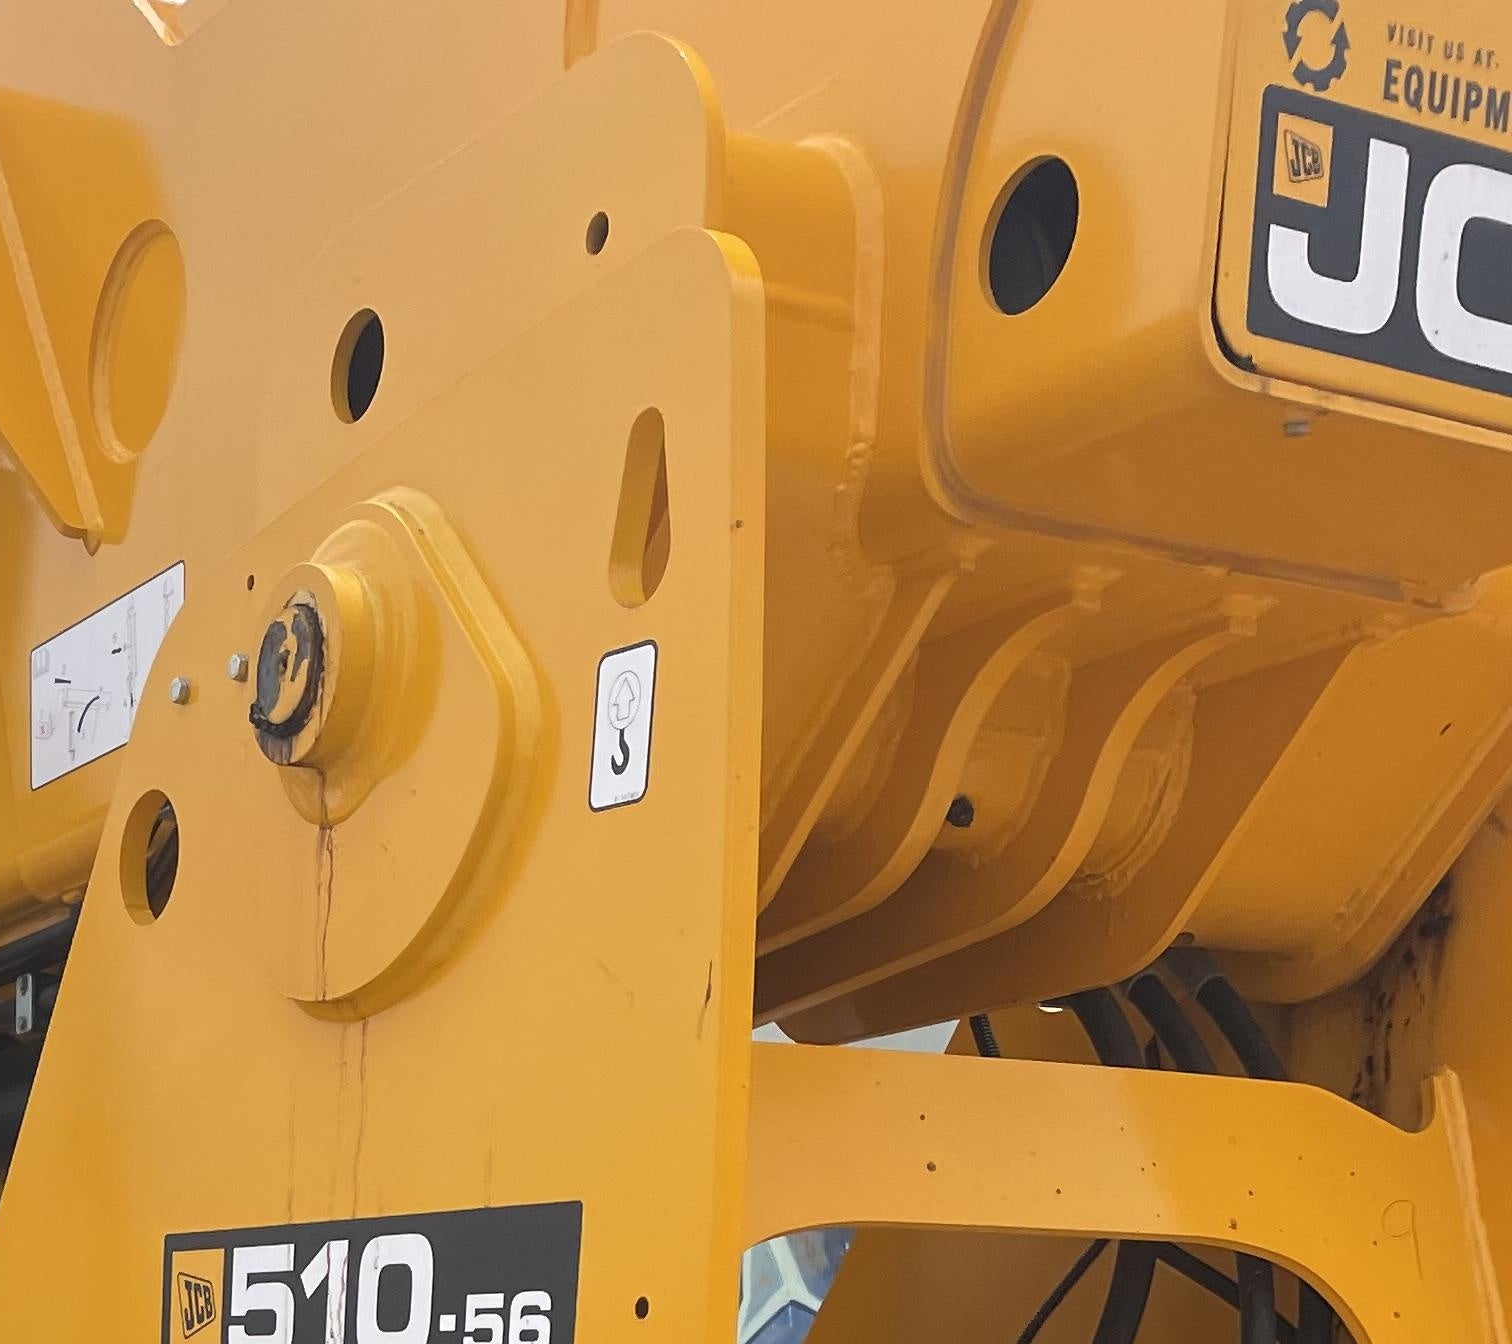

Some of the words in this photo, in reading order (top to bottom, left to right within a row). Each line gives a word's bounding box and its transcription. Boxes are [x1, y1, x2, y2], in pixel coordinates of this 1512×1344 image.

[1387, 23, 1434, 53] VISIT
[1444, 40, 1464, 60] US
[1289, 138, 1321, 177] JCB
[184, 1280, 213, 1330] JCB
